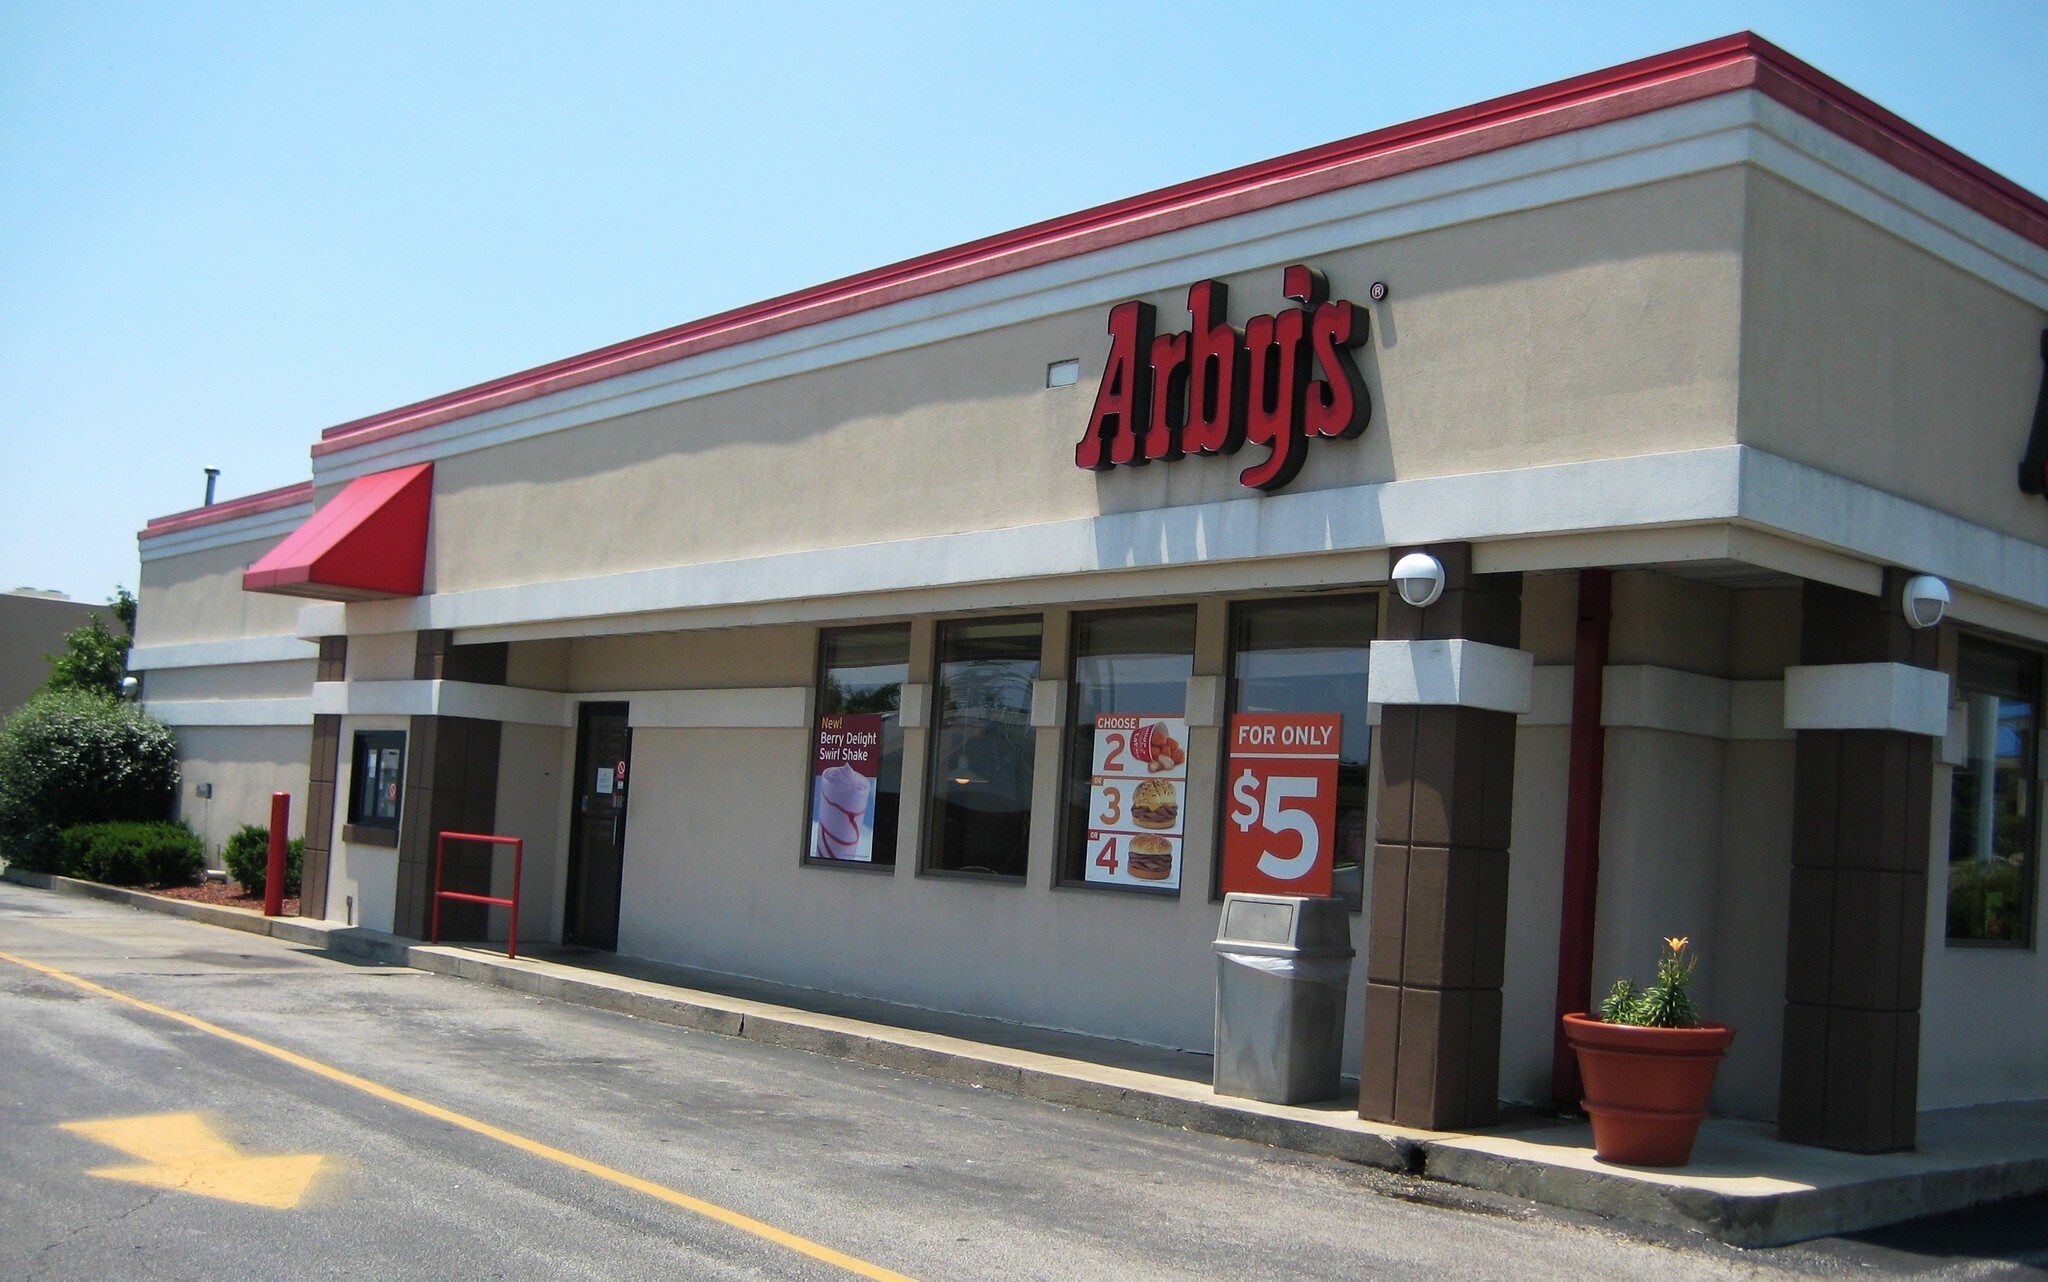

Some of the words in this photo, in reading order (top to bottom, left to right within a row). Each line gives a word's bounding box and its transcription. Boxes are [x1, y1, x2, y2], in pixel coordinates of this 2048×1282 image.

[1075, 264, 1371, 497] Arby's
[821, 717, 843, 729] New!
[1097, 717, 1137, 729] CHOOSE
[1238, 725, 1276, 745] FOR
[1281, 725, 1334, 745] ONLY
[819, 747, 840, 760] Swirl
[842, 748, 868, 761] Shake
[820, 732, 845, 747] Berry
[846, 732, 877, 747] Delight
[1103, 733, 1126, 772] 2
[1099, 786, 1121, 825] 3
[1231, 768, 1320, 880] $5
[1095, 837, 1119, 875] 4
